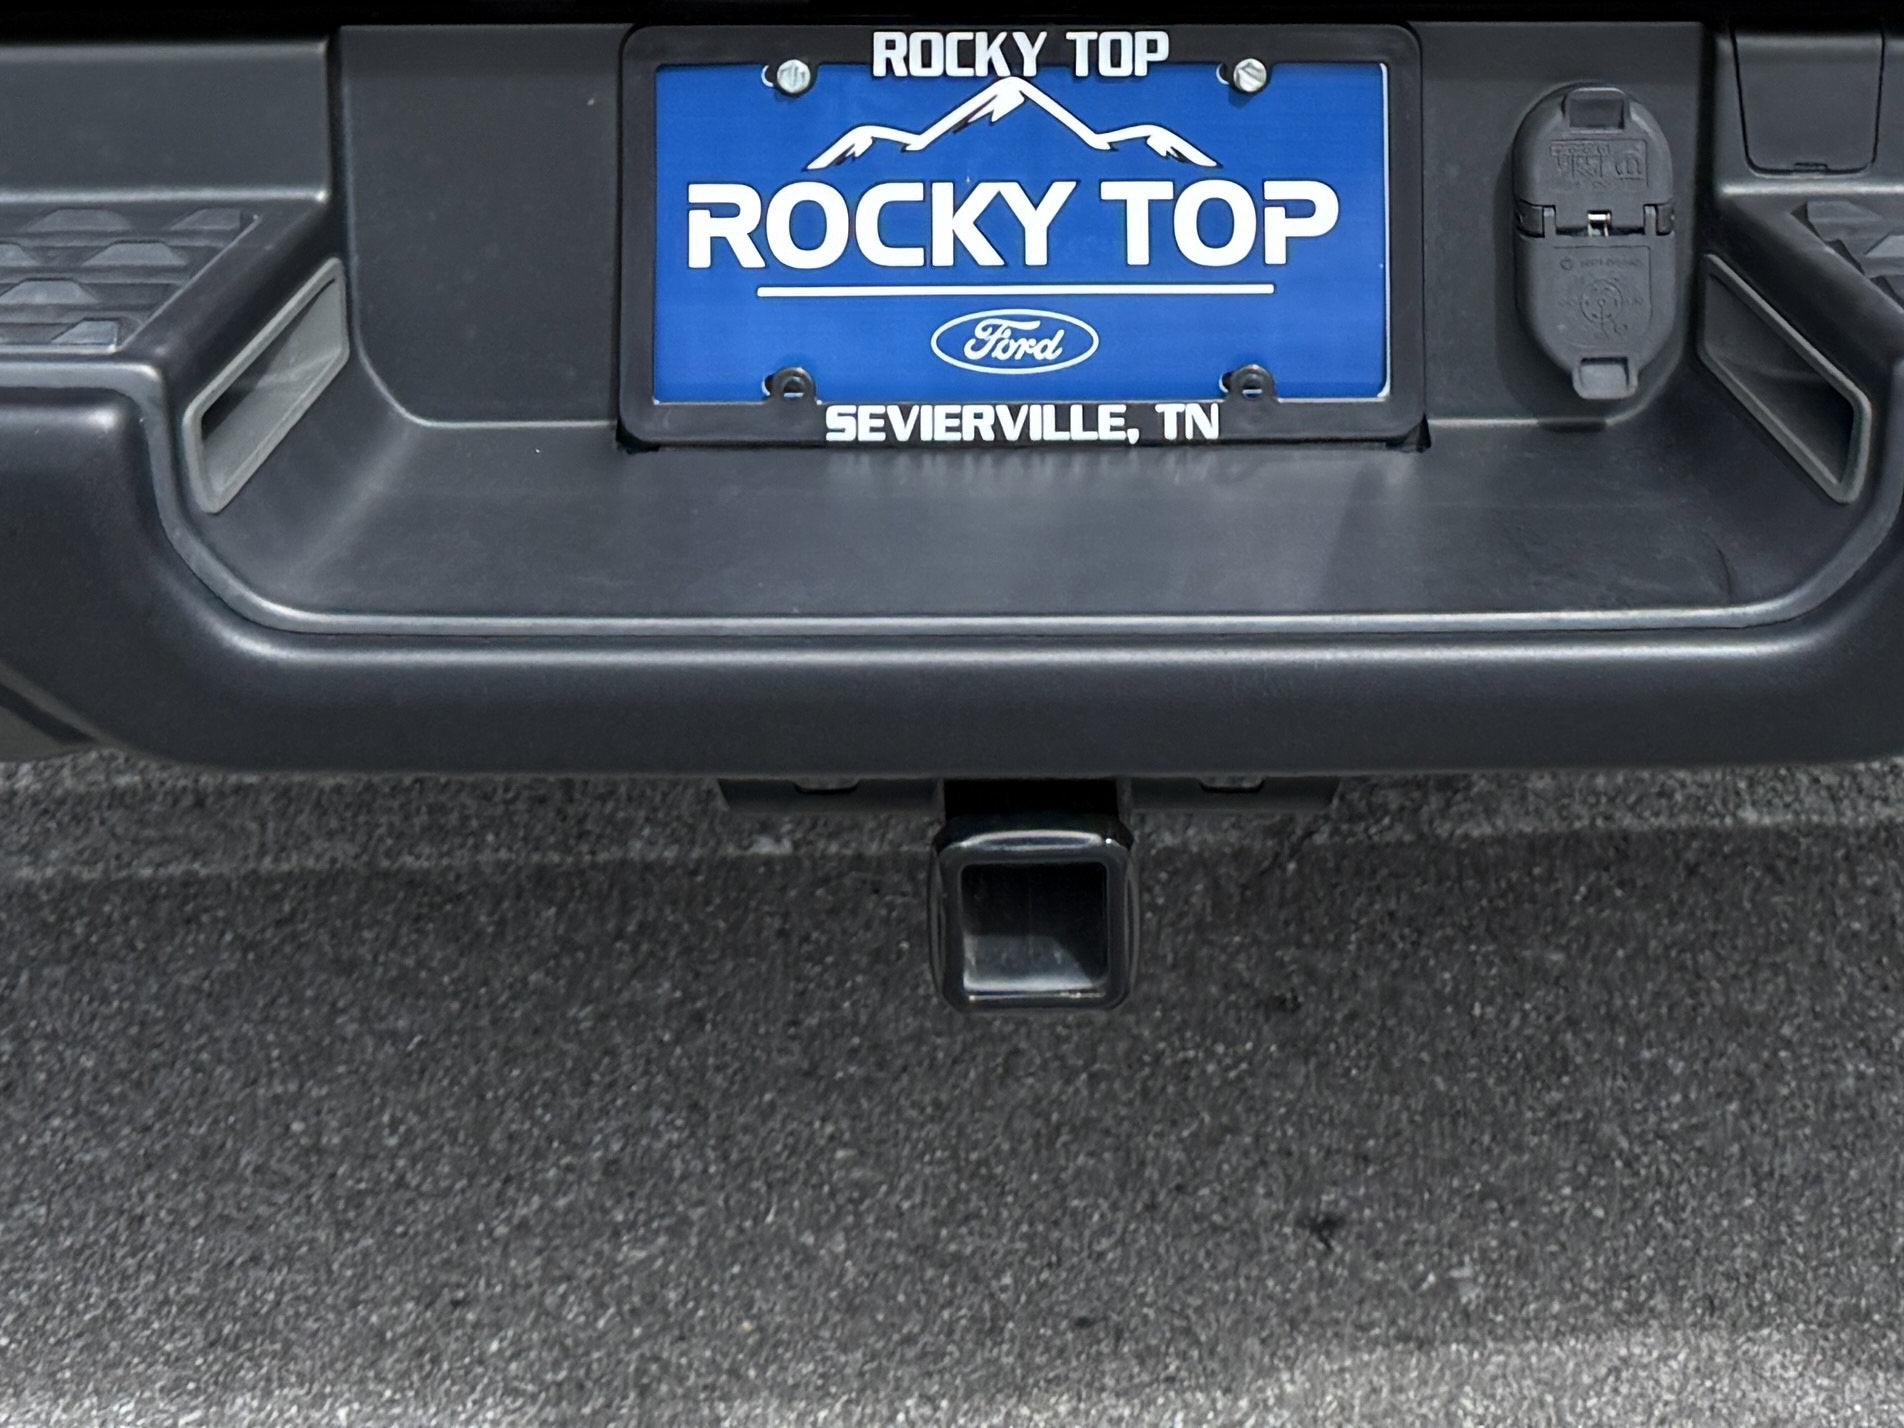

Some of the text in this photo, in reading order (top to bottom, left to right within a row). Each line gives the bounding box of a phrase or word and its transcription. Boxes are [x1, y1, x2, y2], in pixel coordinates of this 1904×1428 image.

[872, 30, 1170, 78] ROCKY TOP
[687, 178, 1341, 270] ROCKY TOP
[963, 317, 1065, 361] Ford
[825, 402, 1220, 445] SEVIERVILLE, TN
